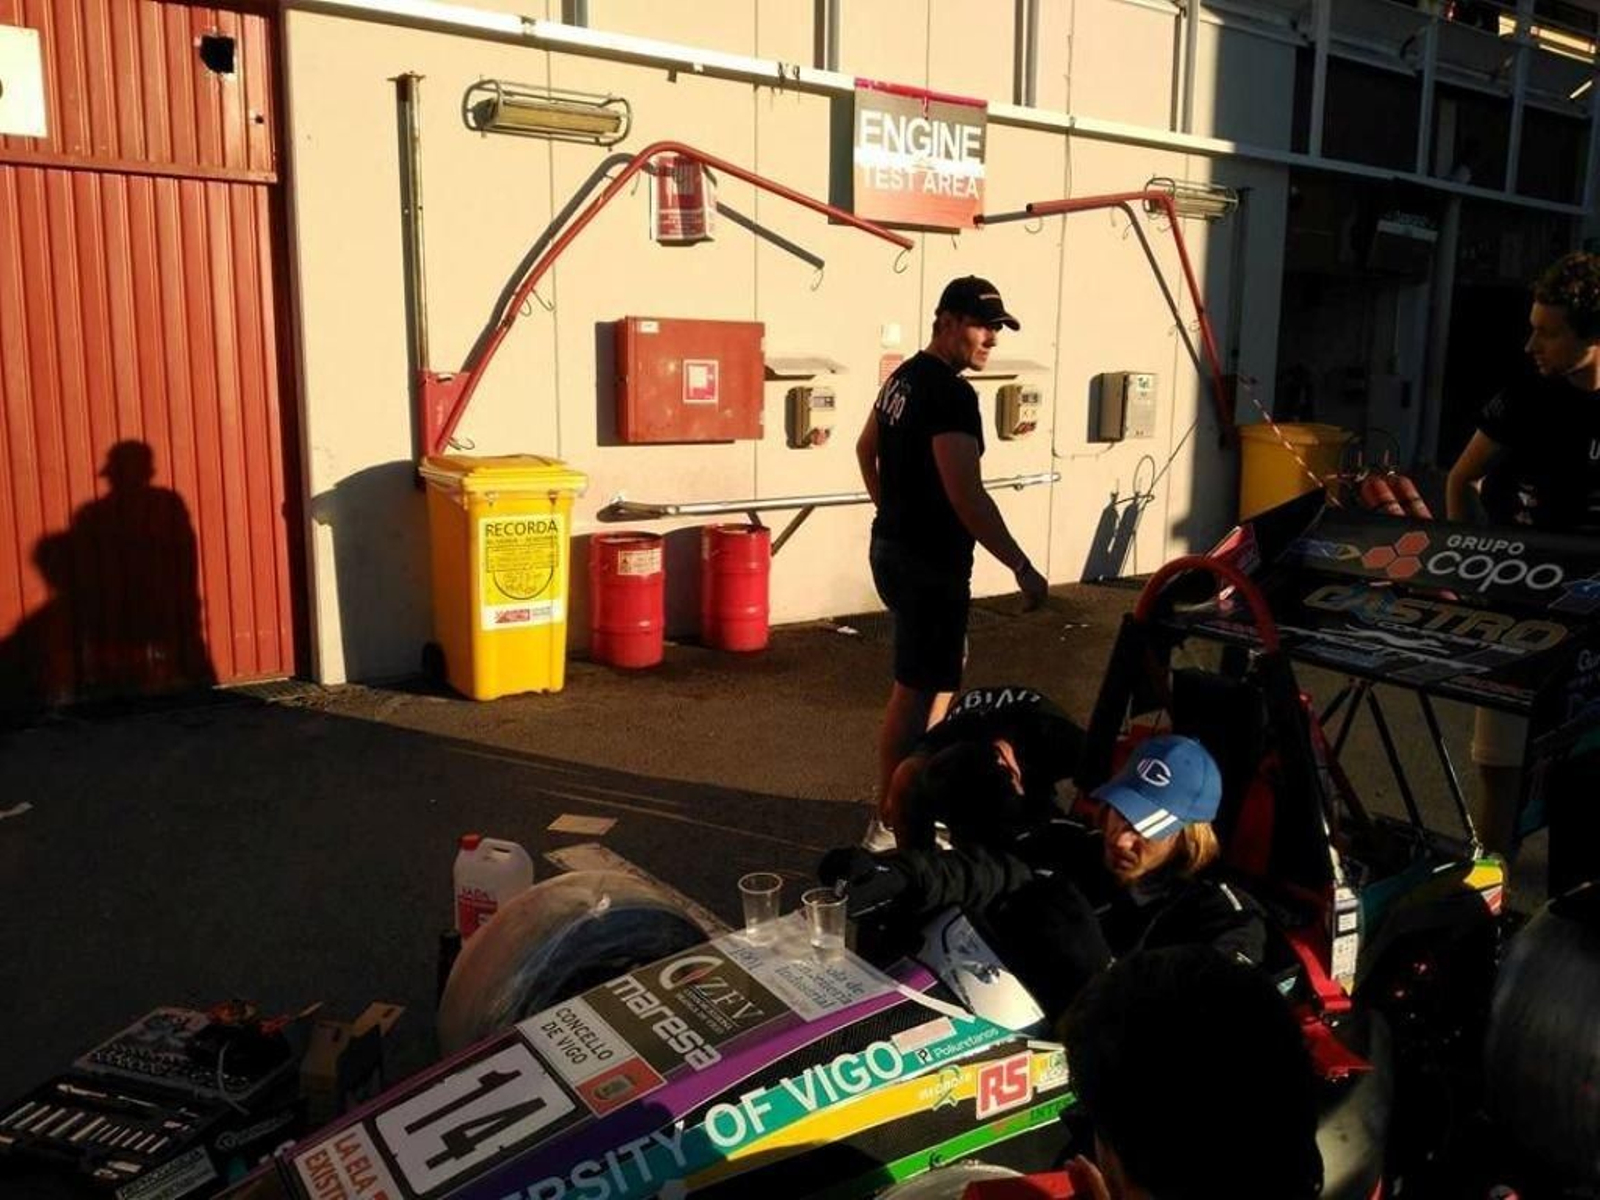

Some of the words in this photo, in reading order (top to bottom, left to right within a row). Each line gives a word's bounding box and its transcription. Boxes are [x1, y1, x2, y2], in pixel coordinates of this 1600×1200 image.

[860, 109, 982, 164] ENGINE
[861, 166, 915, 191] TEST
[923, 170, 980, 200] AREA
[485, 520, 558, 537] RECORDA
[1446, 534, 1525, 556] GRUPO
[541, 1021, 563, 1039] DE
[557, 1035, 588, 1065] VIGO
[556, 1007, 614, 1061] CONCELLO
[606, 975, 723, 1071] maresa
[980, 1056, 1031, 1113] RS
[403, 1069, 548, 1170] 14
[500, 1119, 687, 1200] SITY
[705, 1086, 772, 1148] OF
[779, 1041, 904, 1113] VIGO
[335, 1132, 361, 1161] LA
[346, 1156, 378, 1195] ELA
